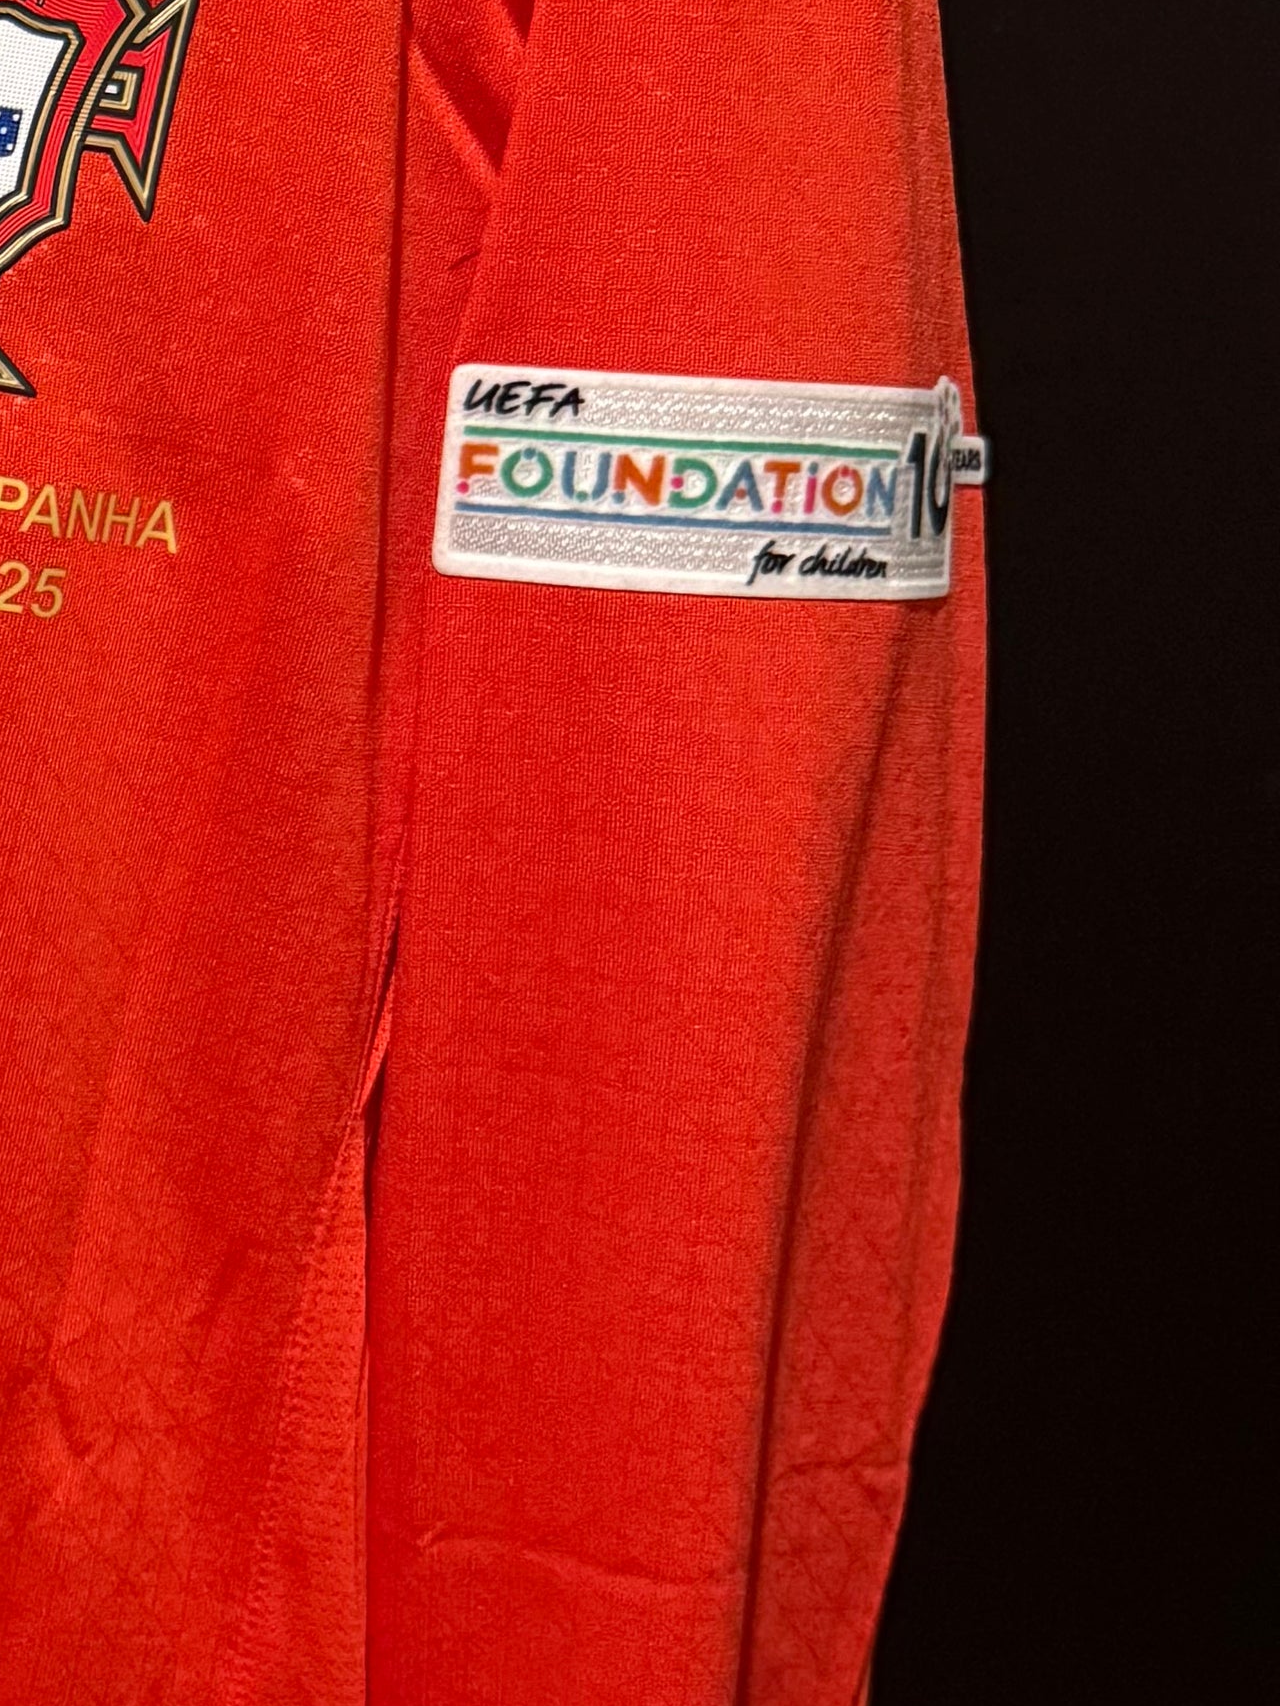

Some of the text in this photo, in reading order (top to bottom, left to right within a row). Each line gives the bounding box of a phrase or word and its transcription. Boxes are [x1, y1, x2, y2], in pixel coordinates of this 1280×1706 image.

[463, 379, 585, 418] UEFA
[745, 539, 887, 585] for children
